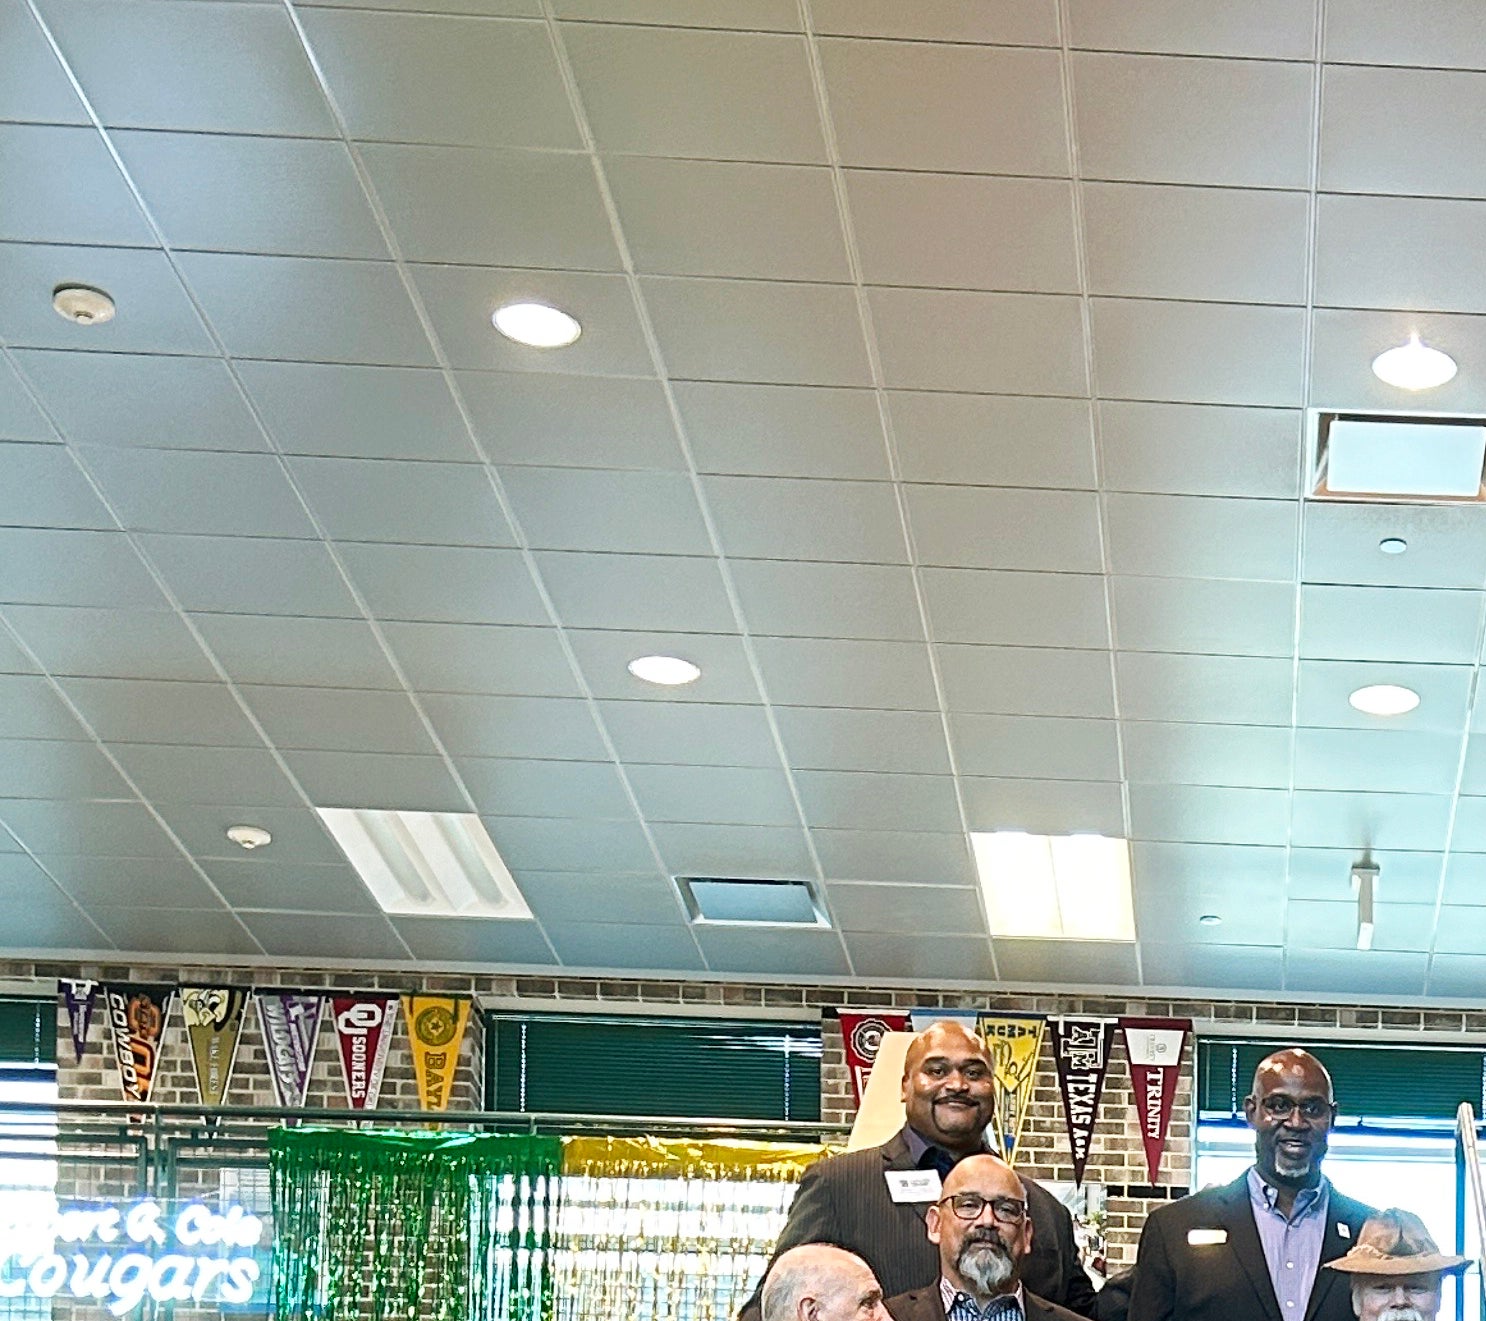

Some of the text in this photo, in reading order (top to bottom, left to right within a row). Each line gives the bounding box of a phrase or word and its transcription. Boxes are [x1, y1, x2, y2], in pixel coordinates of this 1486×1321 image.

[986, 1024, 1037, 1040] TAMUK
[351, 1036, 366, 1099] SOONERS
[424, 1051, 447, 1110] BAYL
[1065, 1073, 1098, 1125] TEXAS
[1146, 1067, 1164, 1140] TRINITY
[0, 1253, 260, 1317] Cougars
